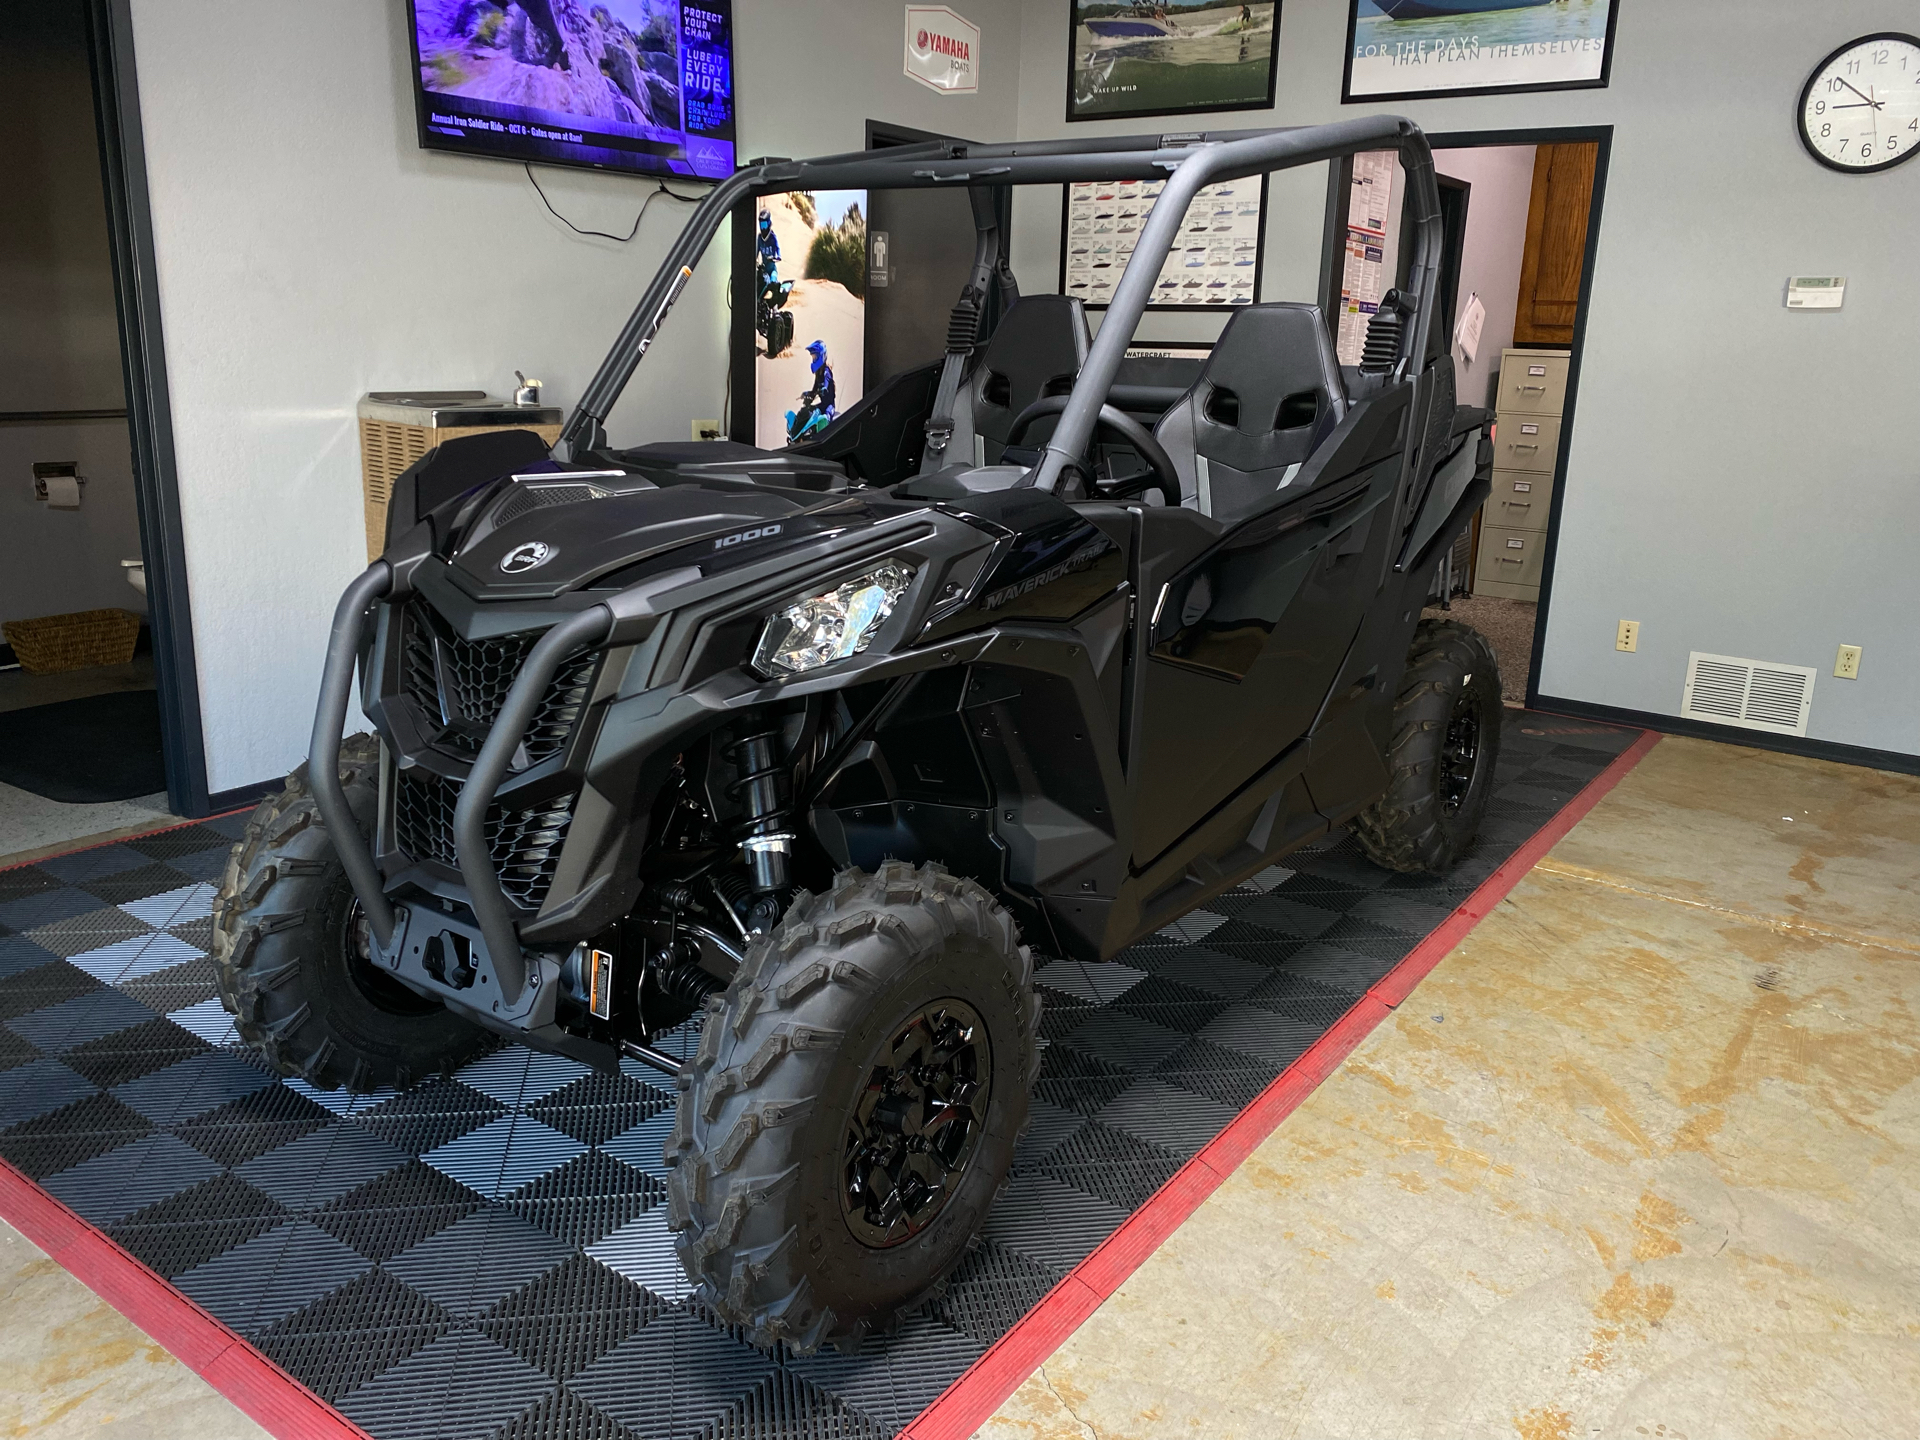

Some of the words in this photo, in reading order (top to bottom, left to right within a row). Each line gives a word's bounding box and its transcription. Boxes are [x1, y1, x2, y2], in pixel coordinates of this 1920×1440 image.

[684, 6, 723, 24] PROTECT
[684, 16, 708, 30] YOUR
[684, 26, 711, 40] CHAIN
[929, 32, 970, 61] YAMAHA
[1356, 43, 1387, 58] FOR
[1396, 40, 1426, 56] THE
[1435, 35, 1479, 51] DAYS
[1392, 51, 1430, 66] THAT
[1438, 48, 1480, 63] PLAN
[1490, 39, 1602, 58] THEMSELVES
[686, 48, 711, 63] LUBE
[714, 54, 723, 64] IT
[1871, 49, 1889, 65] 12
[1900, 55, 1908, 71] 1
[686, 59, 723, 77] EVERY
[950, 59, 970, 73] BOATS
[1846, 59, 1860, 75] 11
[685, 71, 725, 94] RIDE.
[1093, 85, 1109, 94] WAKE
[1121, 84, 1137, 92] WILD
[1826, 77, 1844, 92] 10
[687, 99, 705, 108] GRAB
[707, 103, 725, 112] SOME
[1815, 100, 1826, 115] 9
[688, 114, 701, 122] FOR
[703, 117, 720, 126] YOUR
[710, 111, 727, 120] LUBE
[431, 112, 453, 125] Annual
[454, 115, 467, 127] Iron
[467, 117, 489, 130] Soldier
[490, 120, 504, 133] Ride
[508, 123, 521, 135] OCT
[521, 125, 527, 135] 6
[530, 126, 547, 138] Gates
[547, 131, 561, 141] open
[561, 132, 569, 141] at
[1820, 122, 1832, 138] 8
[1907, 117, 1919, 133] 4
[1839, 138, 1849, 153] 7
[1861, 142, 1872, 158] 6
[1886, 135, 1898, 150] 5
[714, 524, 781, 549] 1000
[513, 553, 538, 563] BRP
[985, 560, 1070, 610] MAVERICK
[1072, 543, 1104, 568] TRAIL
